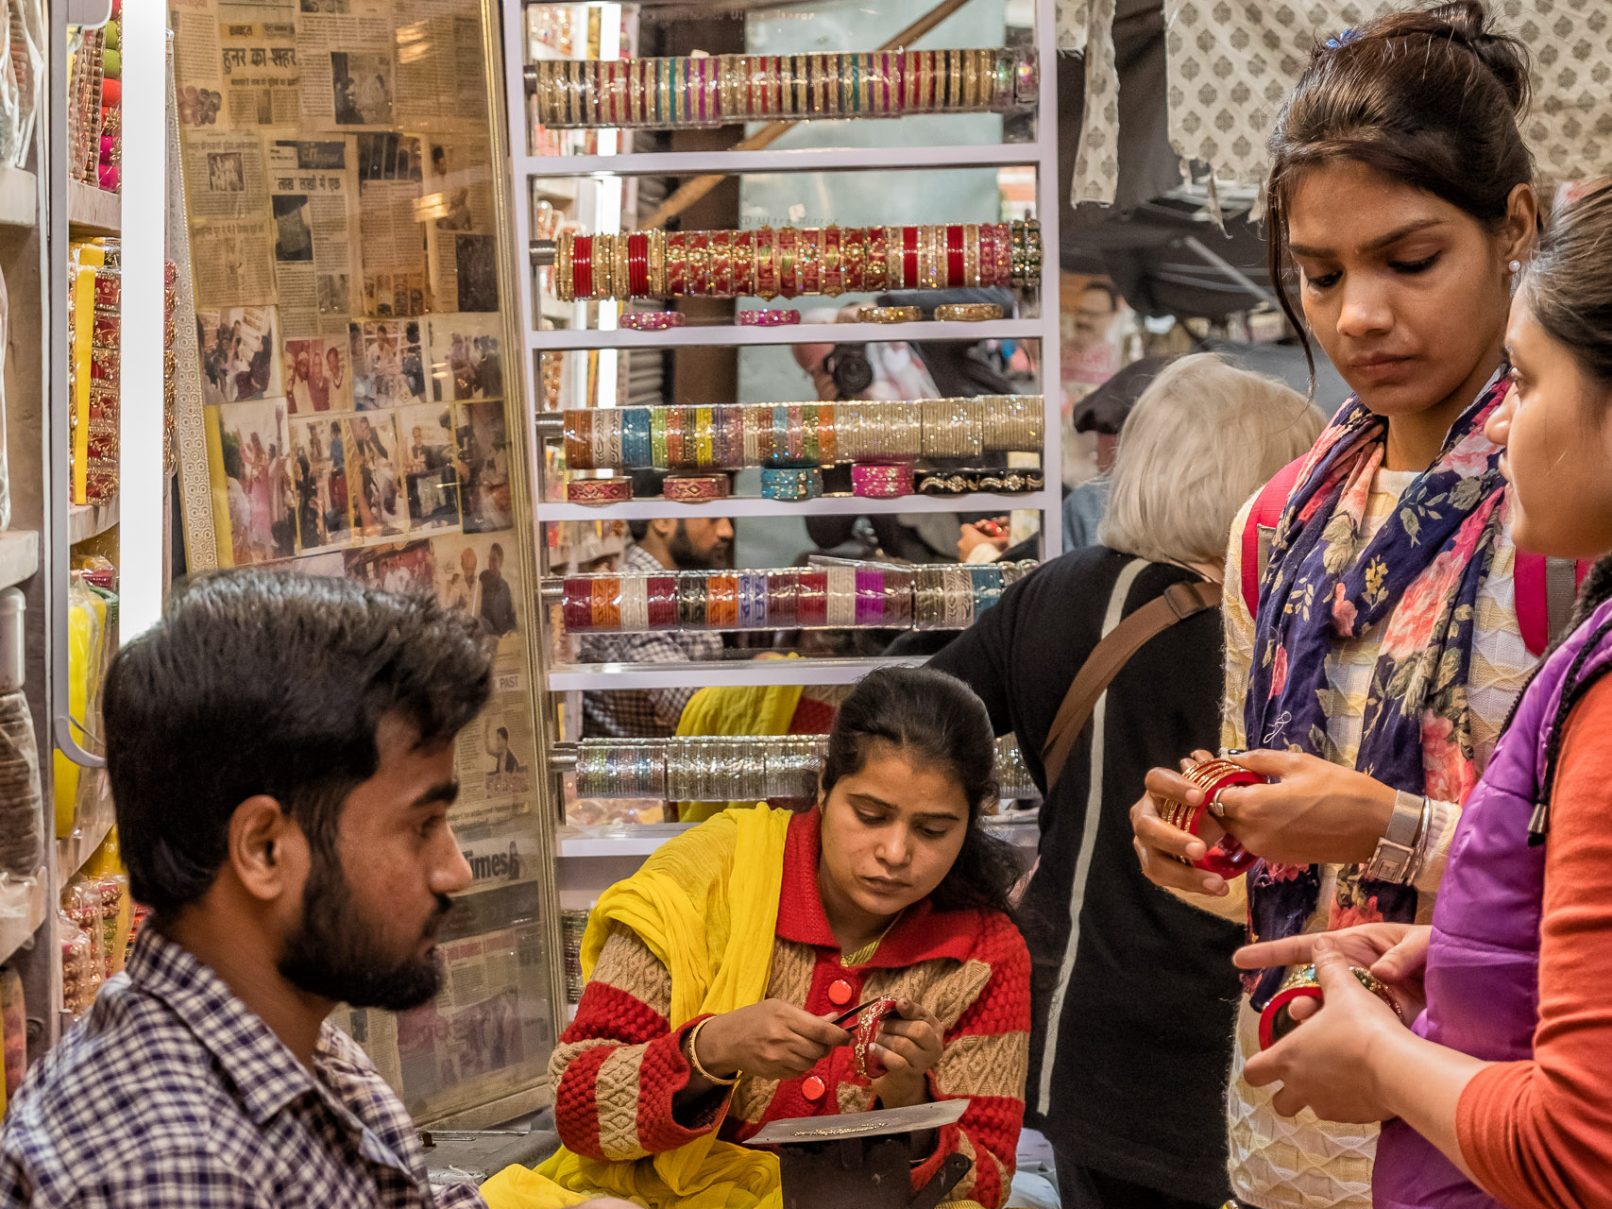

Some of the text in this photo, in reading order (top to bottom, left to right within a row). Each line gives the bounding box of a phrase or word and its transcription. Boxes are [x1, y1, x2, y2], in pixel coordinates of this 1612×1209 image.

[222, 48, 296, 75] हुनर का शहर
[500, 676, 519, 689] PAST
